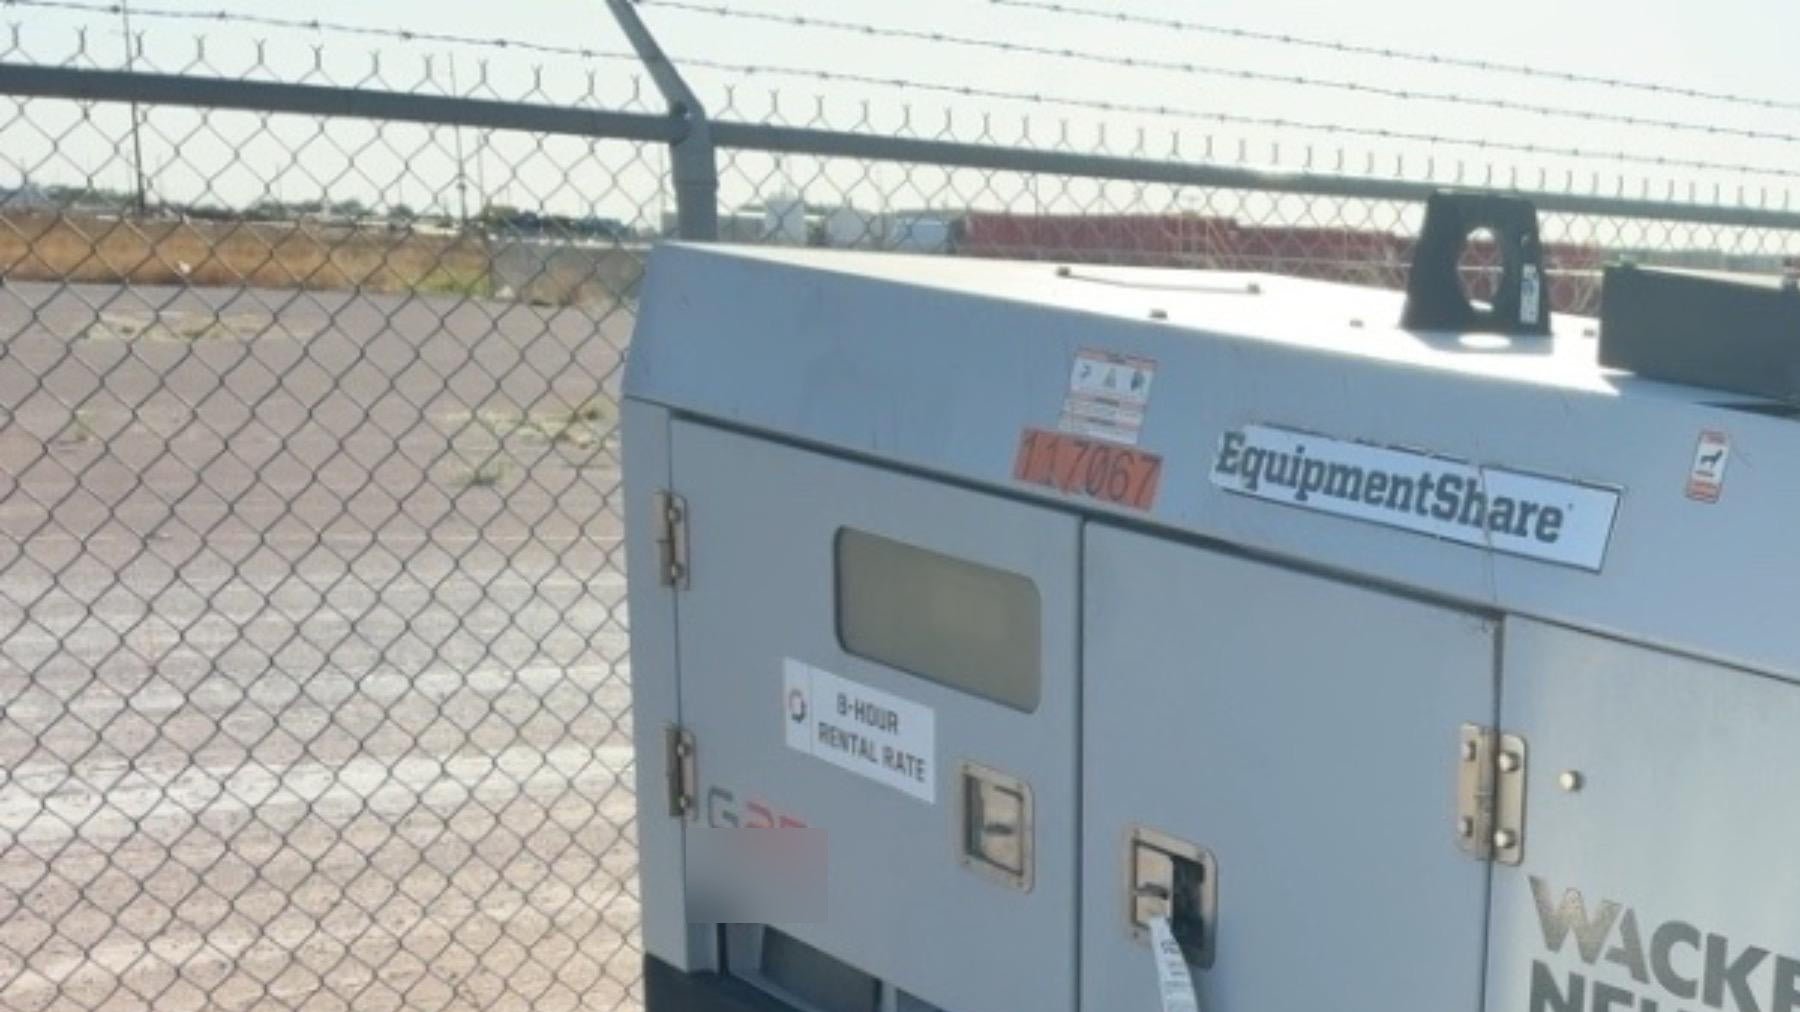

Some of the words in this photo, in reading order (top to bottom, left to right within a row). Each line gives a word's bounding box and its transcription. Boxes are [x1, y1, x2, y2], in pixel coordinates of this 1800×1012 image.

[1214, 430, 1565, 545] EquipmentShare
[817, 721, 878, 764] RENTAL
[881, 746, 927, 784] RATE
